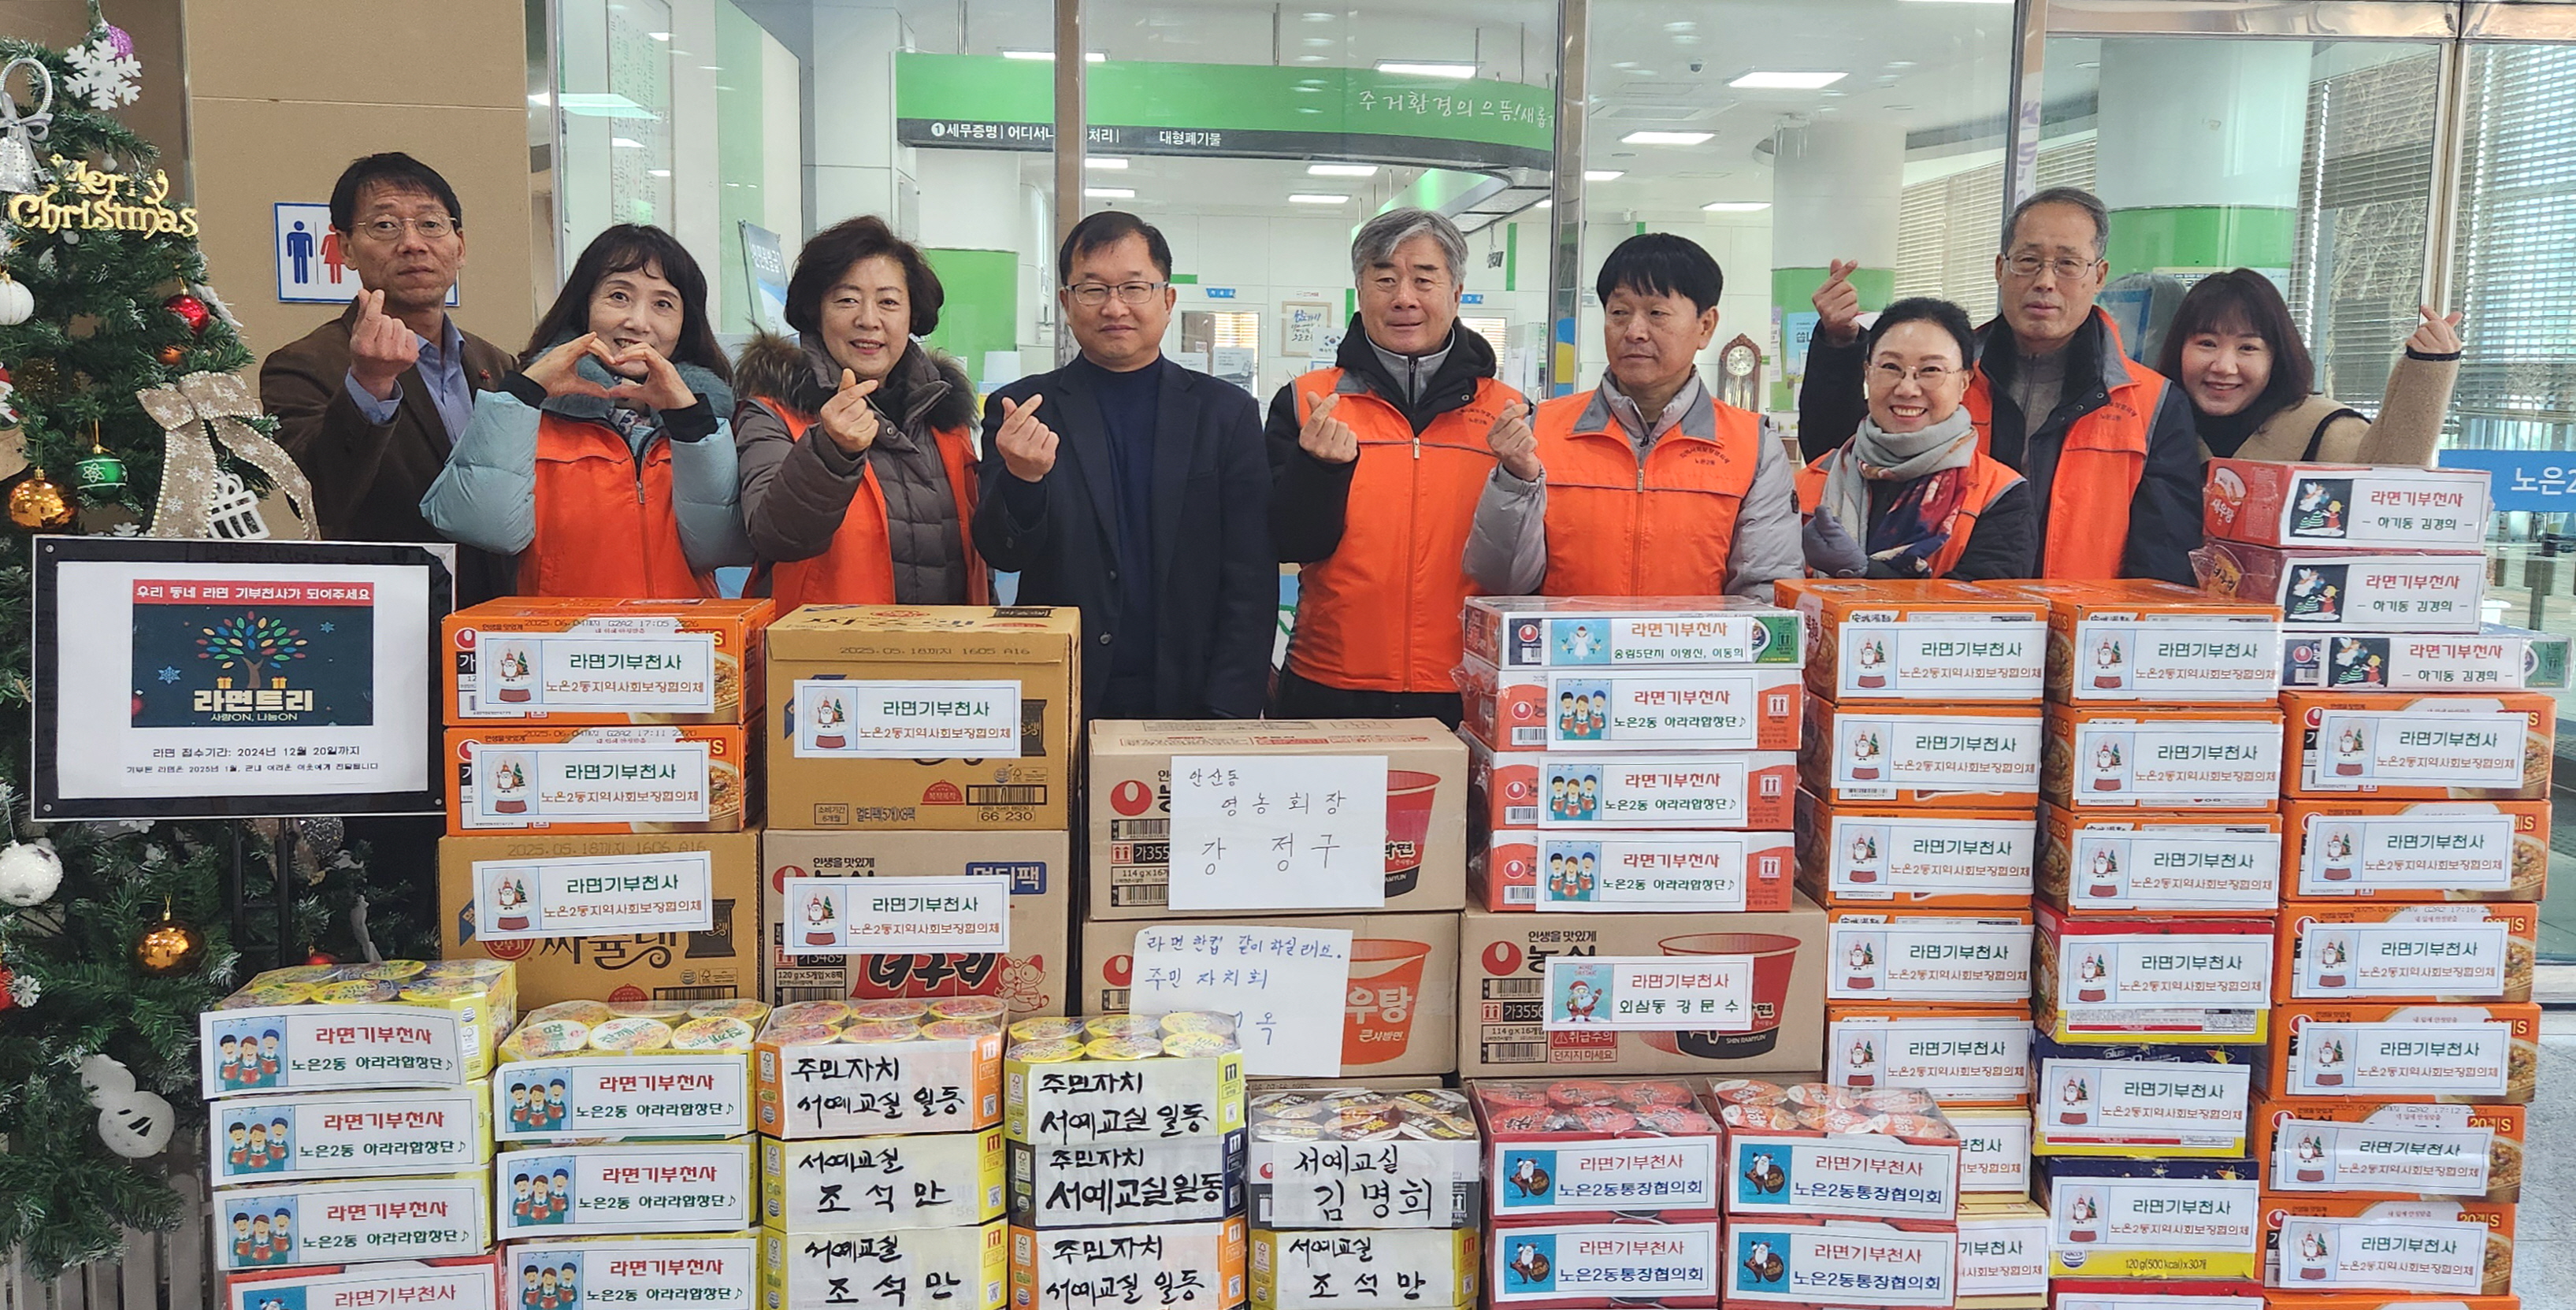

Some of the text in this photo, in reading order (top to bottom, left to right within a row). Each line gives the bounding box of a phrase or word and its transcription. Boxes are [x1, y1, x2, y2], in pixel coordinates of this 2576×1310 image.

[946, 124, 997, 138] 세무증명
[1160, 131, 1221, 146] 대형폐기물
[9, 192, 199, 238] Christmas
[2371, 492, 2463, 507] 라면기부천사
[2378, 518, 2414, 529] 하기동
[2366, 575, 2460, 589] 라면기부천사
[137, 586, 369, 600] 우리 동네 라면 기부천사가 되어주세요
[2374, 600, 2409, 612] 하기동
[1631, 622, 1728, 637] 라면기부천사
[1922, 643, 2022, 657] 라면기부천사
[2158, 644, 2258, 658] 라면기부천사
[2410, 644, 2503, 659] 라면기부천사
[570, 654, 681, 670] 라면기부천사
[2418, 670, 2454, 681] 하기동
[194, 689, 313, 711] 라면트리
[1634, 691, 1730, 705] 라면기부천사
[883, 701, 989, 717] 라면기부천사
[1614, 716, 1736, 728] 노은2동 아라라합창단
[1916, 737, 2017, 752] 라면기부천사
[2400, 731, 2497, 748] 라면기부천사
[153, 748, 175, 758] 라면
[238, 748, 276, 756] 2024년
[314, 746, 359, 755] 20일까지
[2158, 746, 2257, 760] 라면기부천사
[566, 764, 676, 780] 라면기부천사
[1189, 768, 1239, 787] 안산동
[1625, 774, 1720, 789] 라면기부천사
[1605, 799, 1728, 811] 노은2동 아라라합창단
[982, 811, 1032, 822] 66 230
[1913, 840, 2012, 855] 라면기부천사
[2388, 835, 2485, 850] 라면기부천사
[1624, 853, 1720, 868] 라면기부천사
[2154, 852, 2254, 869] 라면기부천사
[567, 874, 678, 894] 라면기부천사
[1603, 878, 1726, 891] 노은2동 아라라합창단
[872, 897, 978, 913] 라면기부천사
[1910, 945, 2009, 960] 라면기부천사
[2381, 942, 2478, 957] 라면기부천사
[2142, 956, 2242, 970] 라면기부천사
[1632, 975, 1729, 989] 라면기부천사
[1619, 1000, 1666, 1014] 외삼동
[1910, 1041, 2006, 1056] 라면기부천사
[2381, 1042, 2480, 1056] 라면기부천사
[291, 1056, 443, 1071] 노은2동 아라라합창단
[791, 1056, 900, 1082] 주민자치
[1039, 1071, 1142, 1095] 주민자치
[2125, 1082, 2224, 1099] 라면기부천사
[576, 1104, 723, 1118] 노은2동 아라라합창단
[798, 1086, 965, 1129] 서예교실 일동
[1040, 1104, 1208, 1145] 서예교실 일동
[299, 1141, 455, 1158] 노은2동 아라라합창단
[799, 1148, 904, 1175] 서예교실
[1049, 1148, 1143, 1170] 주민자치
[1294, 1145, 1399, 1177] 서예교실
[1558, 1180, 1702, 1197] 노은2동통장협의회
[1794, 1182, 1942, 1204] 노은2동통장협의회
[579, 1194, 726, 1209] 노은2동 아라라합창단
[2133, 1199, 2231, 1215] 라면기부천사
[303, 1230, 458, 1249] 노은2동 아라라합창단
[804, 1235, 903, 1268] 서예교실
[1052, 1234, 1163, 1264] 주민자치
[1289, 1237, 1373, 1267] 서예교실
[1559, 1267, 1703, 1283] 노은2동통장협의회
[1793, 1271, 1940, 1290] 노은2동통장협의회
[587, 1287, 732, 1301] 노은2동 아라라합창단
[1046, 1270, 1205, 1310] 서예교실 일동
